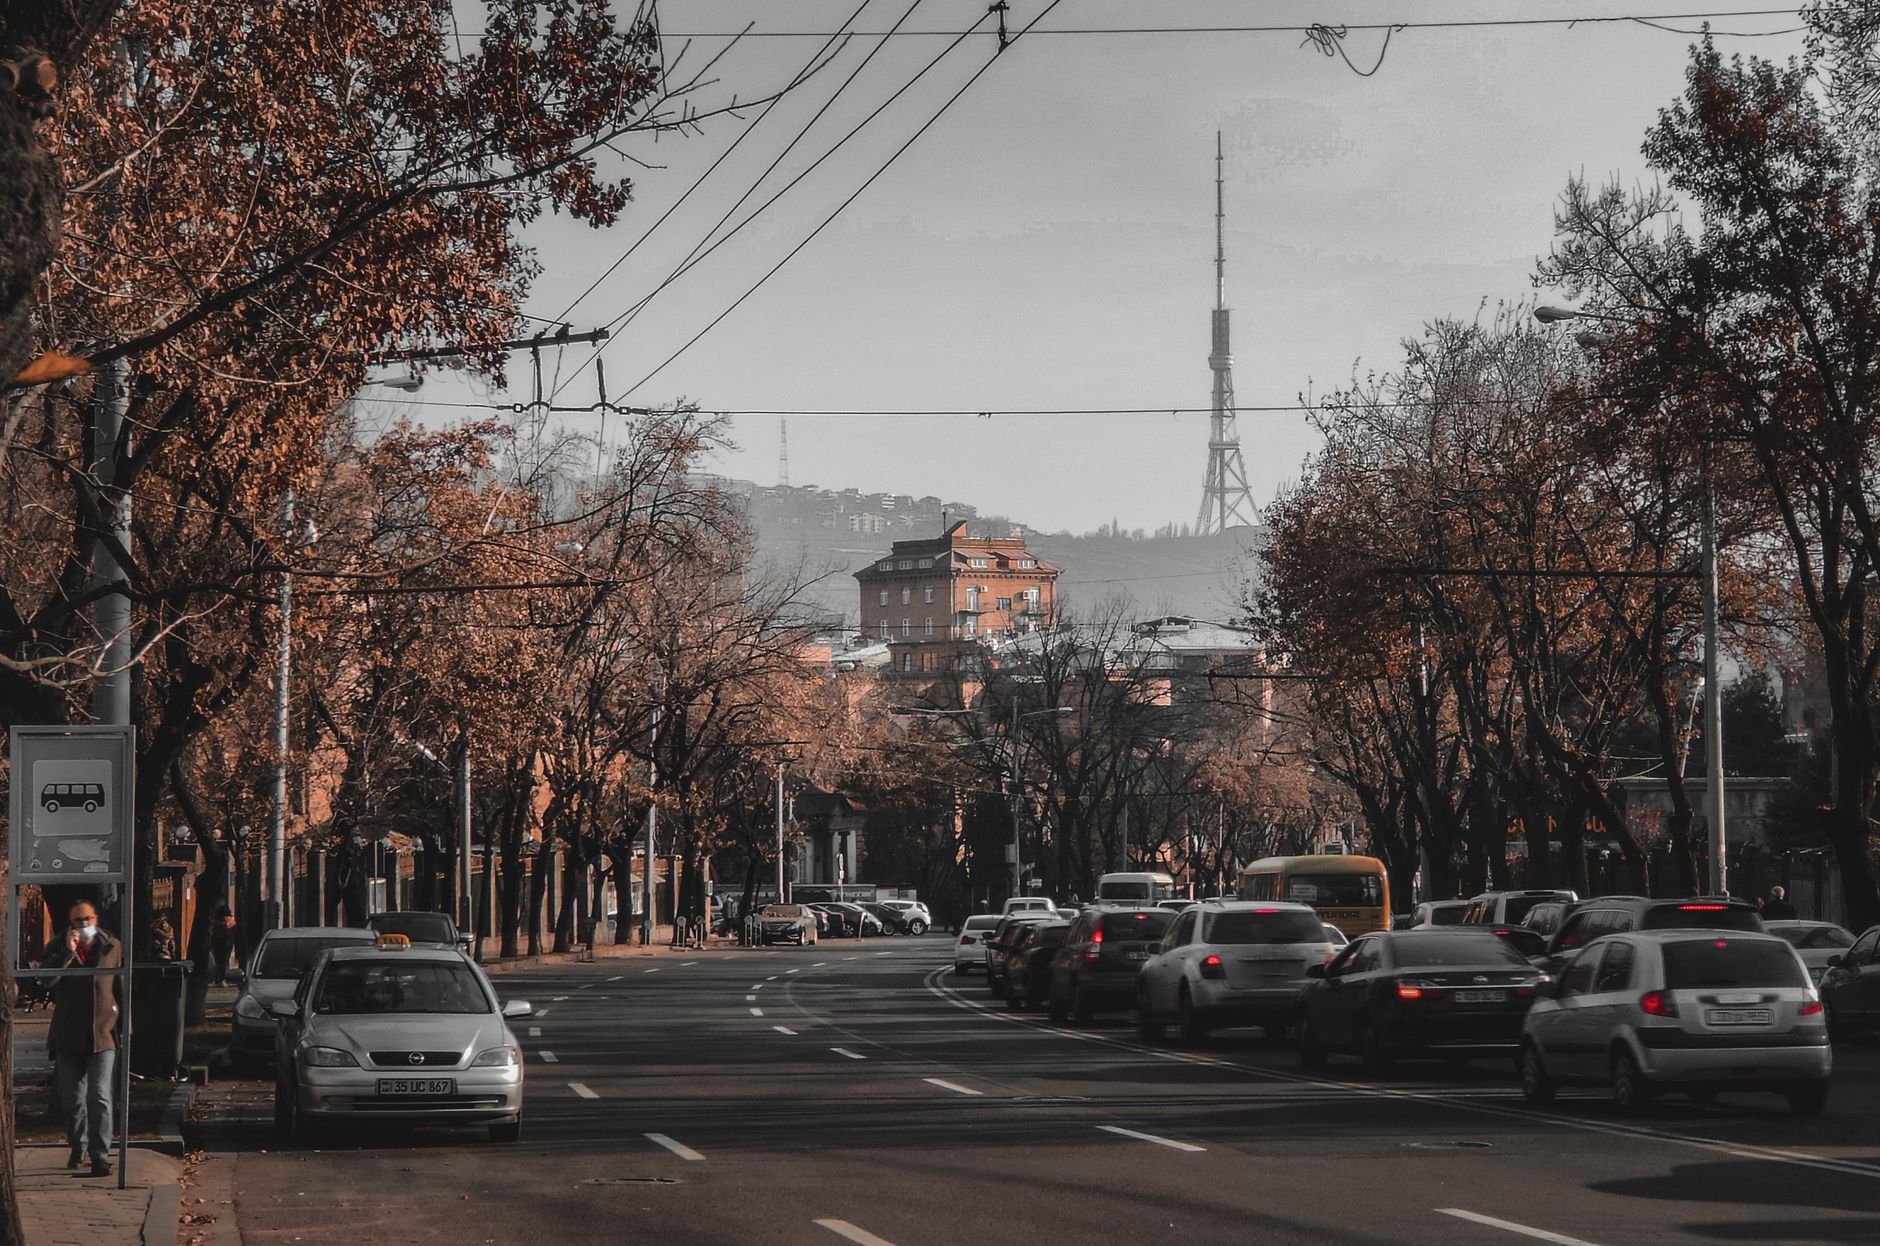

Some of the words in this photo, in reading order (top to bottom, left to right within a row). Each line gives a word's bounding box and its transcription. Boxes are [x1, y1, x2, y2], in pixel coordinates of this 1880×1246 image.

[383, 937, 404, 945] TAXI
[395, 1081, 408, 1093] 35
[410, 1081, 426, 1093] UC
[429, 1081, 449, 1093] 867
